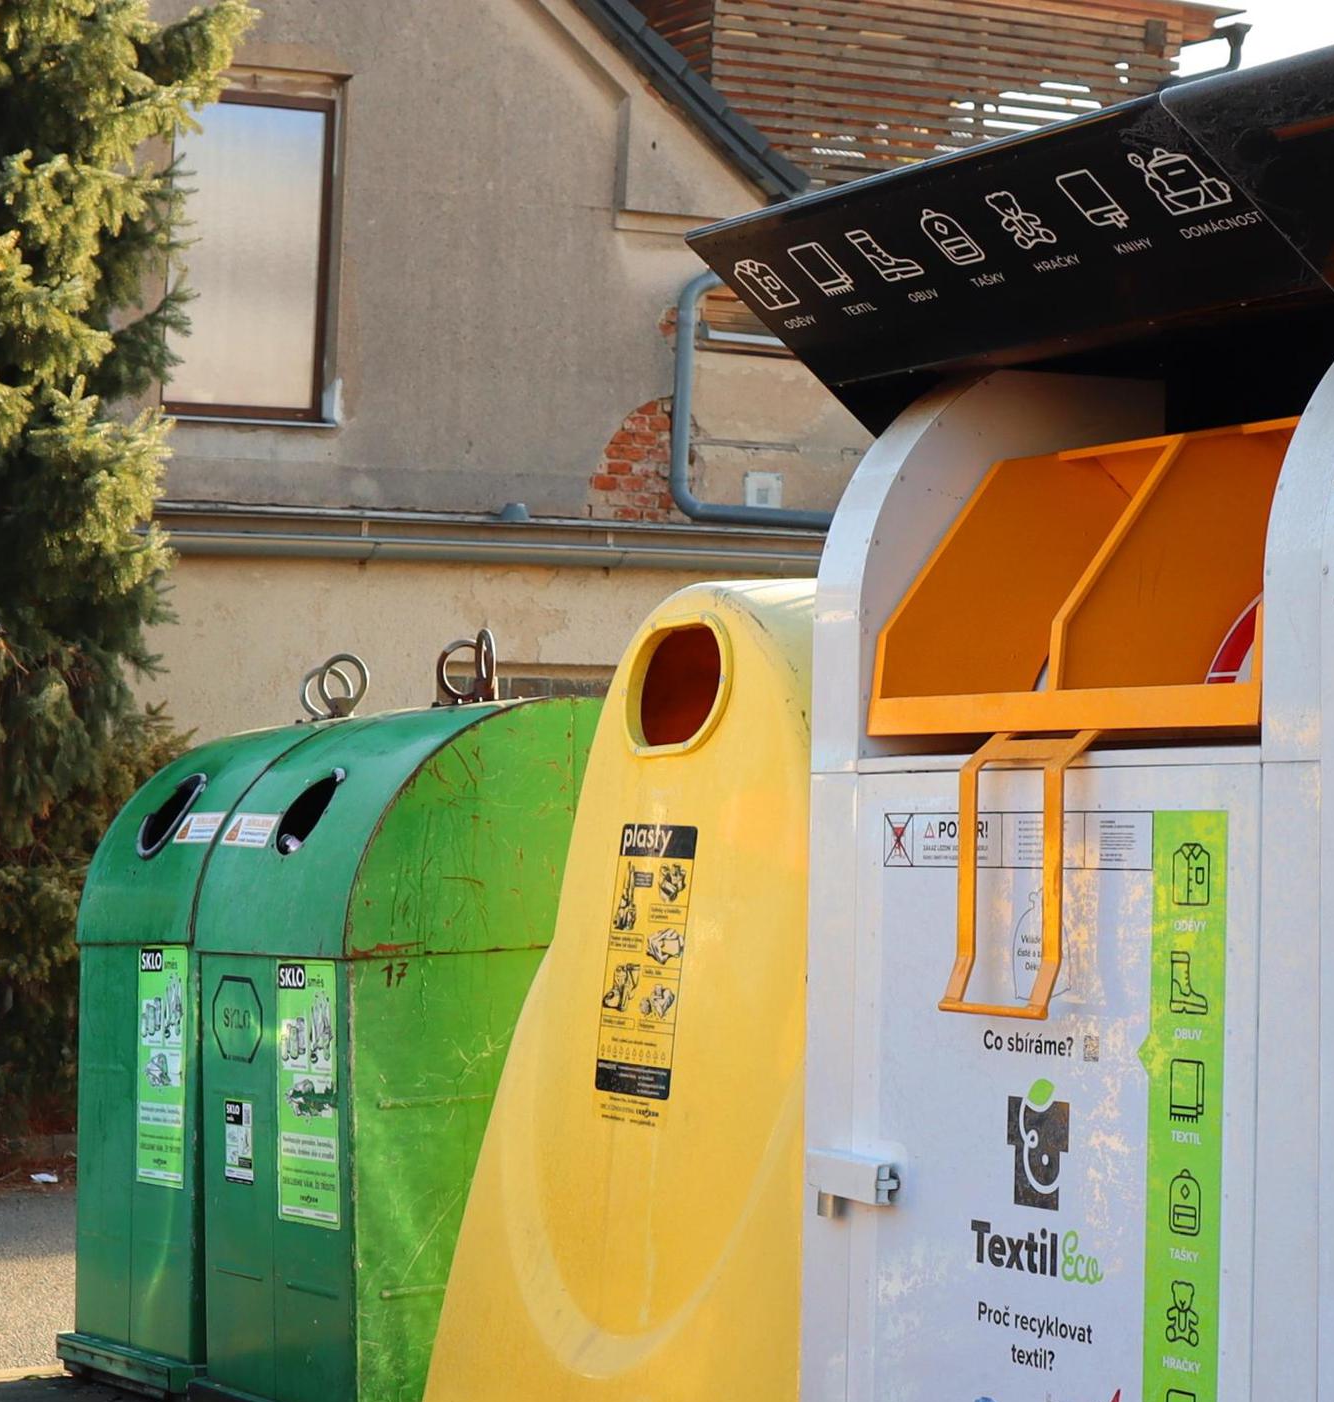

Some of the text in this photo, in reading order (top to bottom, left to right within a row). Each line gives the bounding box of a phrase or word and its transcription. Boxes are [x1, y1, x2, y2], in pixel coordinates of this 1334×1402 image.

[1179, 210, 1263, 240] DOMÁCNOST
[1113, 237, 1154, 255] KNIHY
[1033, 254, 1081, 273] HRAČKY
[970, 272, 1006, 289] TAŠKY
[907, 288, 939, 303] OBUV
[842, 302, 878, 317] TEXTIL
[784, 314, 817, 330] ODĚVY
[938, 821, 988, 839] POR!
[622, 824, 673, 857] plasty
[1174, 919, 1207, 933] ODĚVY
[141, 952, 162, 970] SKLO
[279, 966, 305, 988] SKLO
[983, 1030, 1074, 1058] Co sbíráme?
[1174, 1028, 1203, 1042] OBUV
[1171, 1130, 1202, 1146] TEXTIL
[1169, 1247, 1199, 1264] TAŠKY
[977, 1301, 1093, 1345] Proč recyklovat
[1011, 1344, 1056, 1372] textil?
[1162, 1355, 1201, 1374] HRAČKY
